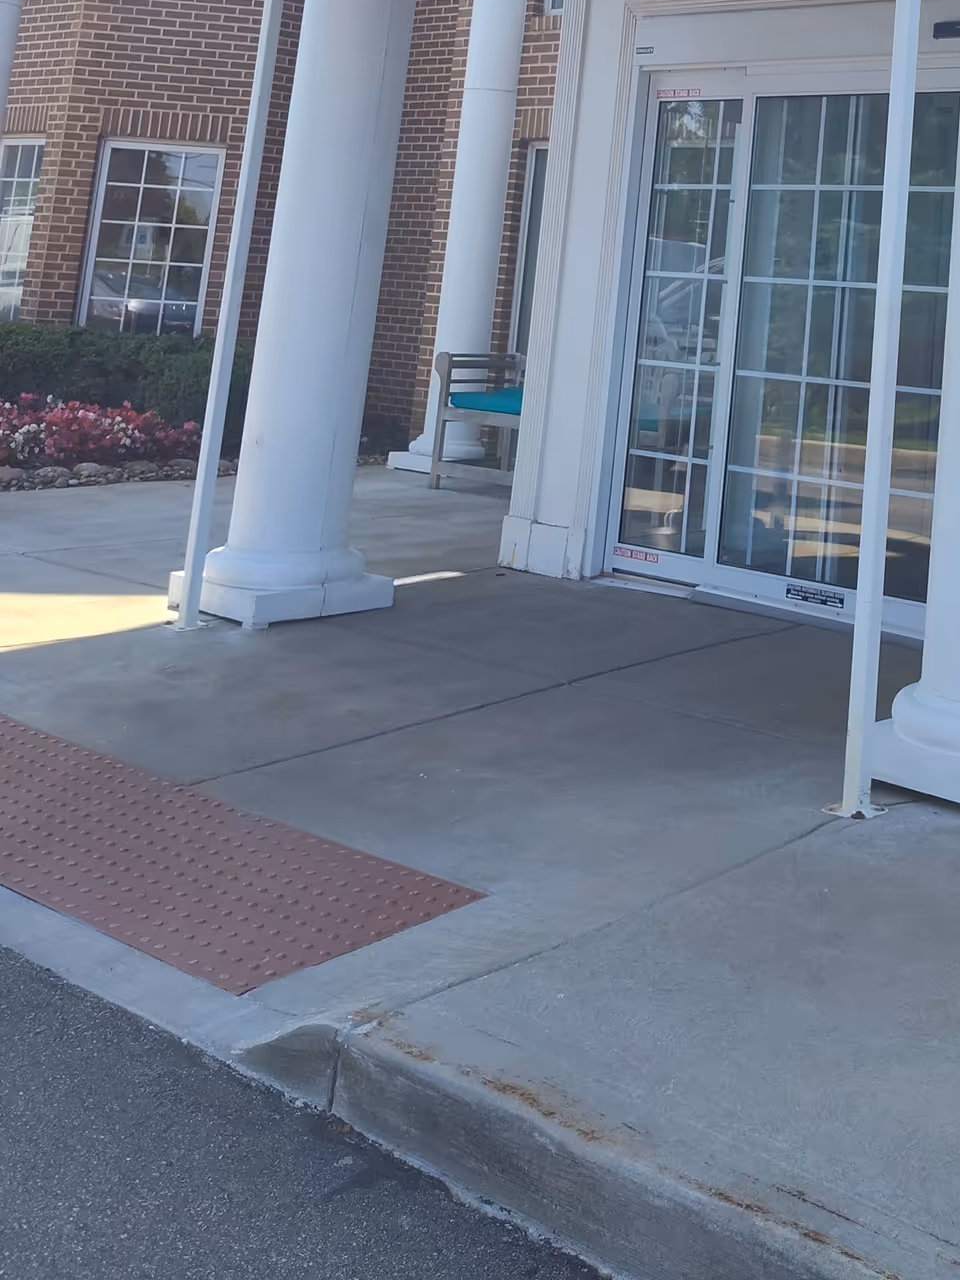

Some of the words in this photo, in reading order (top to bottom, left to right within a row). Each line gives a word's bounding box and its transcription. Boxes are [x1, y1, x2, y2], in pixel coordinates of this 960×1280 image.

[675, 89, 688, 97] STAND
[614, 547, 631, 557] CAUTION
[632, 550, 646, 560] STAND
[647, 553, 658, 562] BACK
